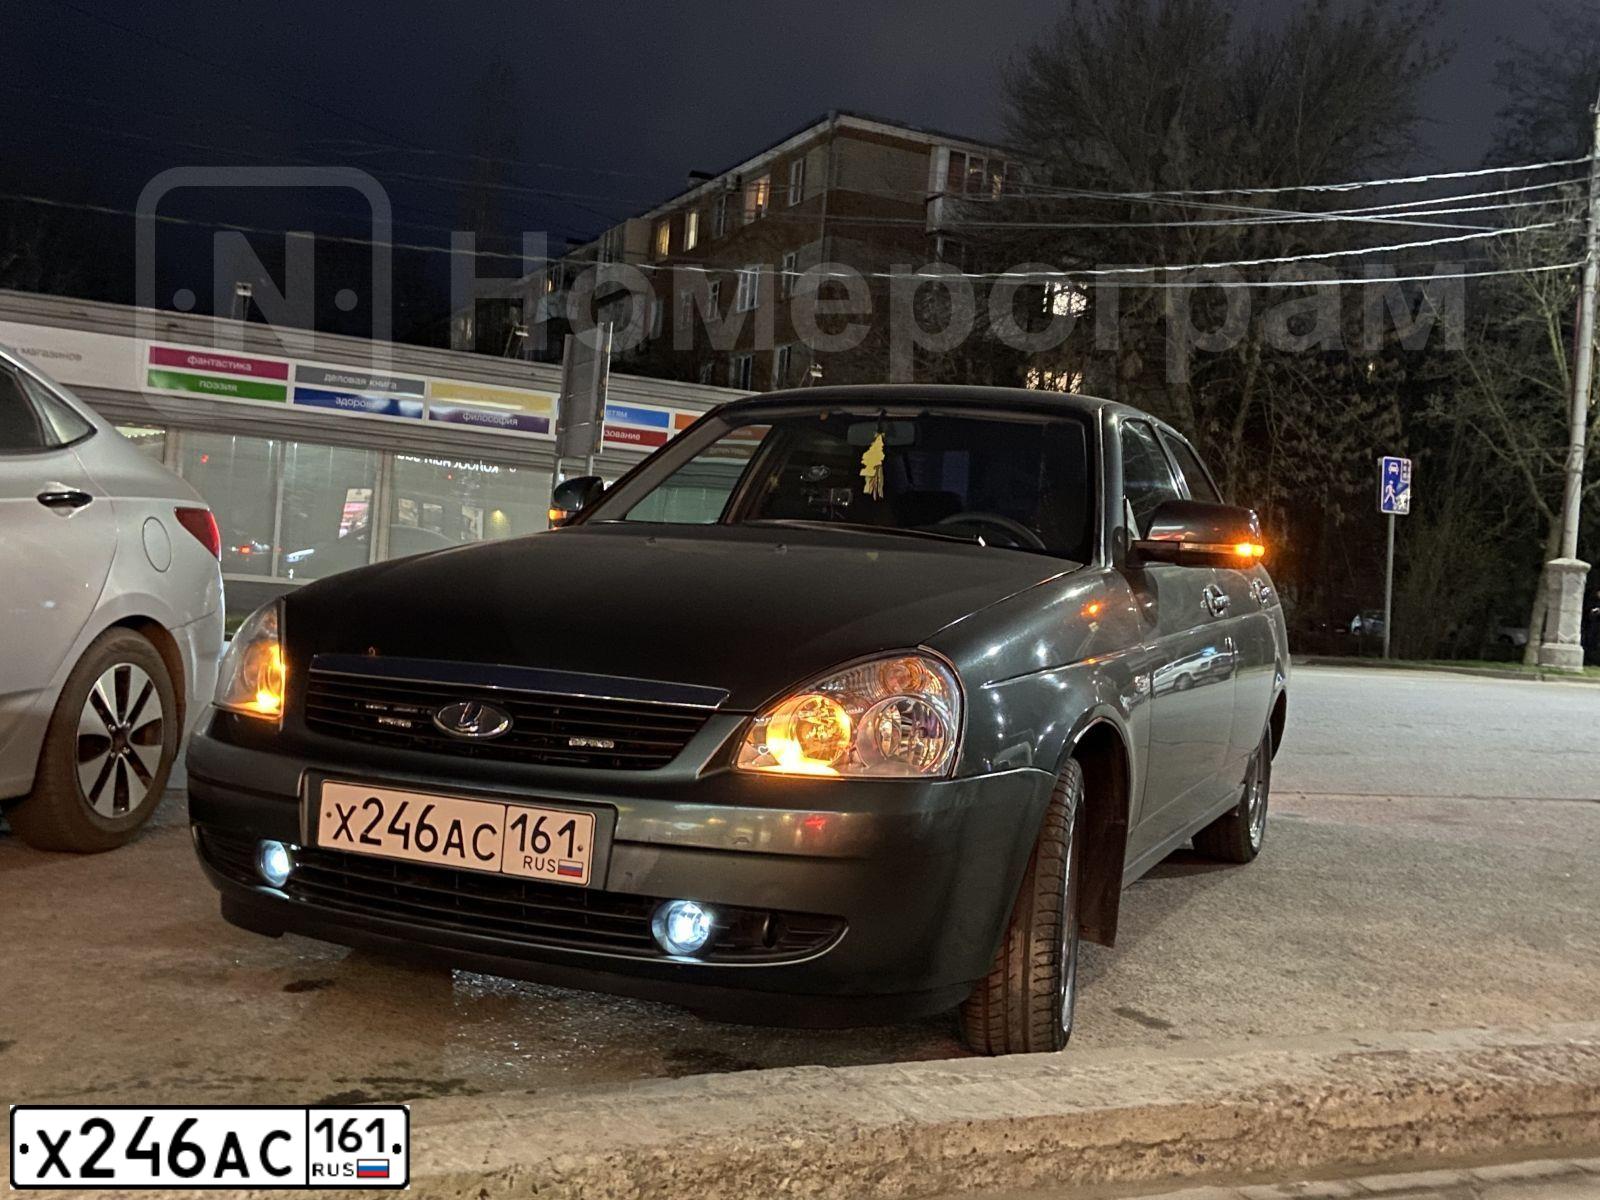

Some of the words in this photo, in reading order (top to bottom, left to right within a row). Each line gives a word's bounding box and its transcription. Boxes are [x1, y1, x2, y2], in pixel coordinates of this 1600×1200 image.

[187, 355, 252, 371] фантастика
[324, 373, 367, 385] деловая
[199, 380, 237, 392] поэзия
[462, 412, 518, 426] философия
[605, 409, 628, 418] етям
[604, 430, 641, 440] зование
[510, 812, 578, 858] 161
[523, 855, 556, 873] RUS
